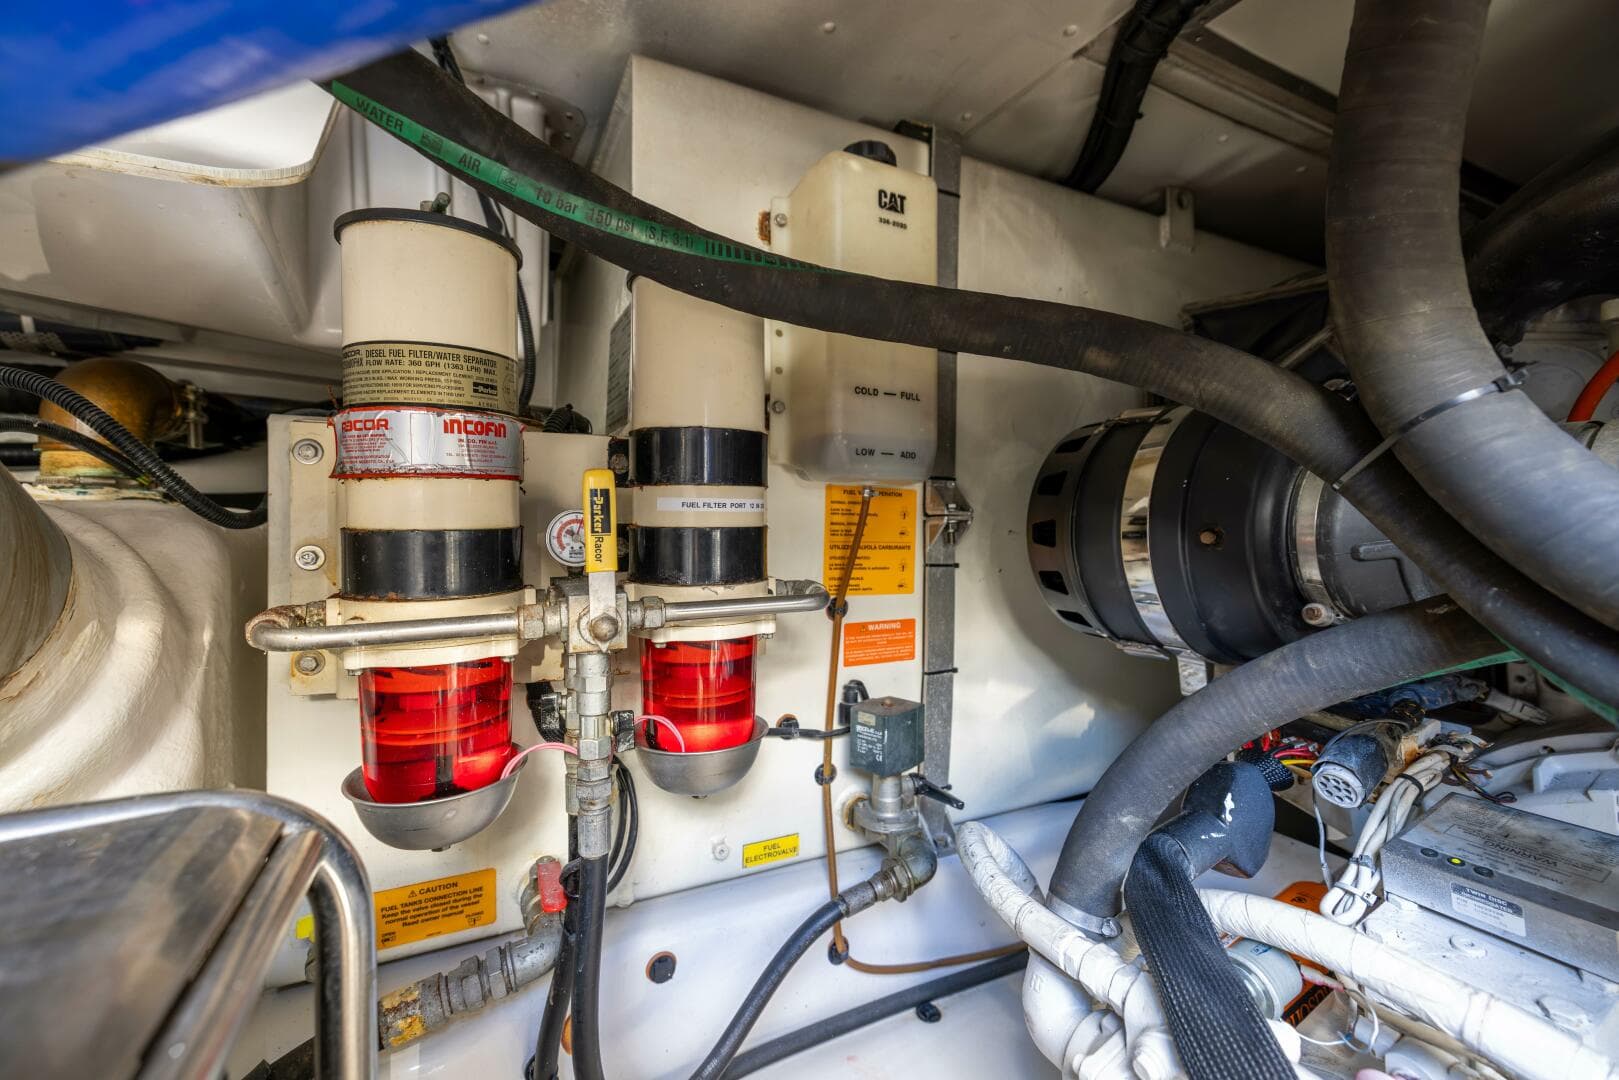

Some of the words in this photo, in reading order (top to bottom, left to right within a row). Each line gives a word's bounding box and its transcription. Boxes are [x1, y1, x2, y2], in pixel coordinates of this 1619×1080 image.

[356, 97, 404, 133] WATER
[458, 152, 482, 174] AIR
[536, 186, 554, 203] 10
[555, 192, 579, 216] bar
[588, 207, 614, 228] 150
[615, 213, 634, 234] psi
[878, 189, 906, 214] CAT
[365, 349, 387, 358] DIESEL
[388, 349, 406, 358] FUEL
[408, 349, 461, 363] FILTER/WATER
[425, 360, 441, 368] GPH
[466, 365, 482, 374] LPH)
[854, 386, 879, 397] COLD
[900, 391, 921, 401] FULL
[855, 448, 876, 457] LOW
[900, 451, 917, 460] ADD
[681, 501, 701, 509] FUEL
[592, 495, 604, 534] Parker
[594, 536, 604, 563] Racor
[867, 621, 902, 632] WARNING
[1483, 840, 1558, 867] WARNING
[418, 882, 458, 895] CAUTION
[381, 905, 399, 913] FUEL
[399, 899, 423, 909] TANKS
[423, 890, 468, 903] CONNECTION
[468, 886, 483, 894] LINE
[381, 910, 399, 919] Keep
[384, 916, 409, 925] normal
[409, 908, 441, 920] operation
